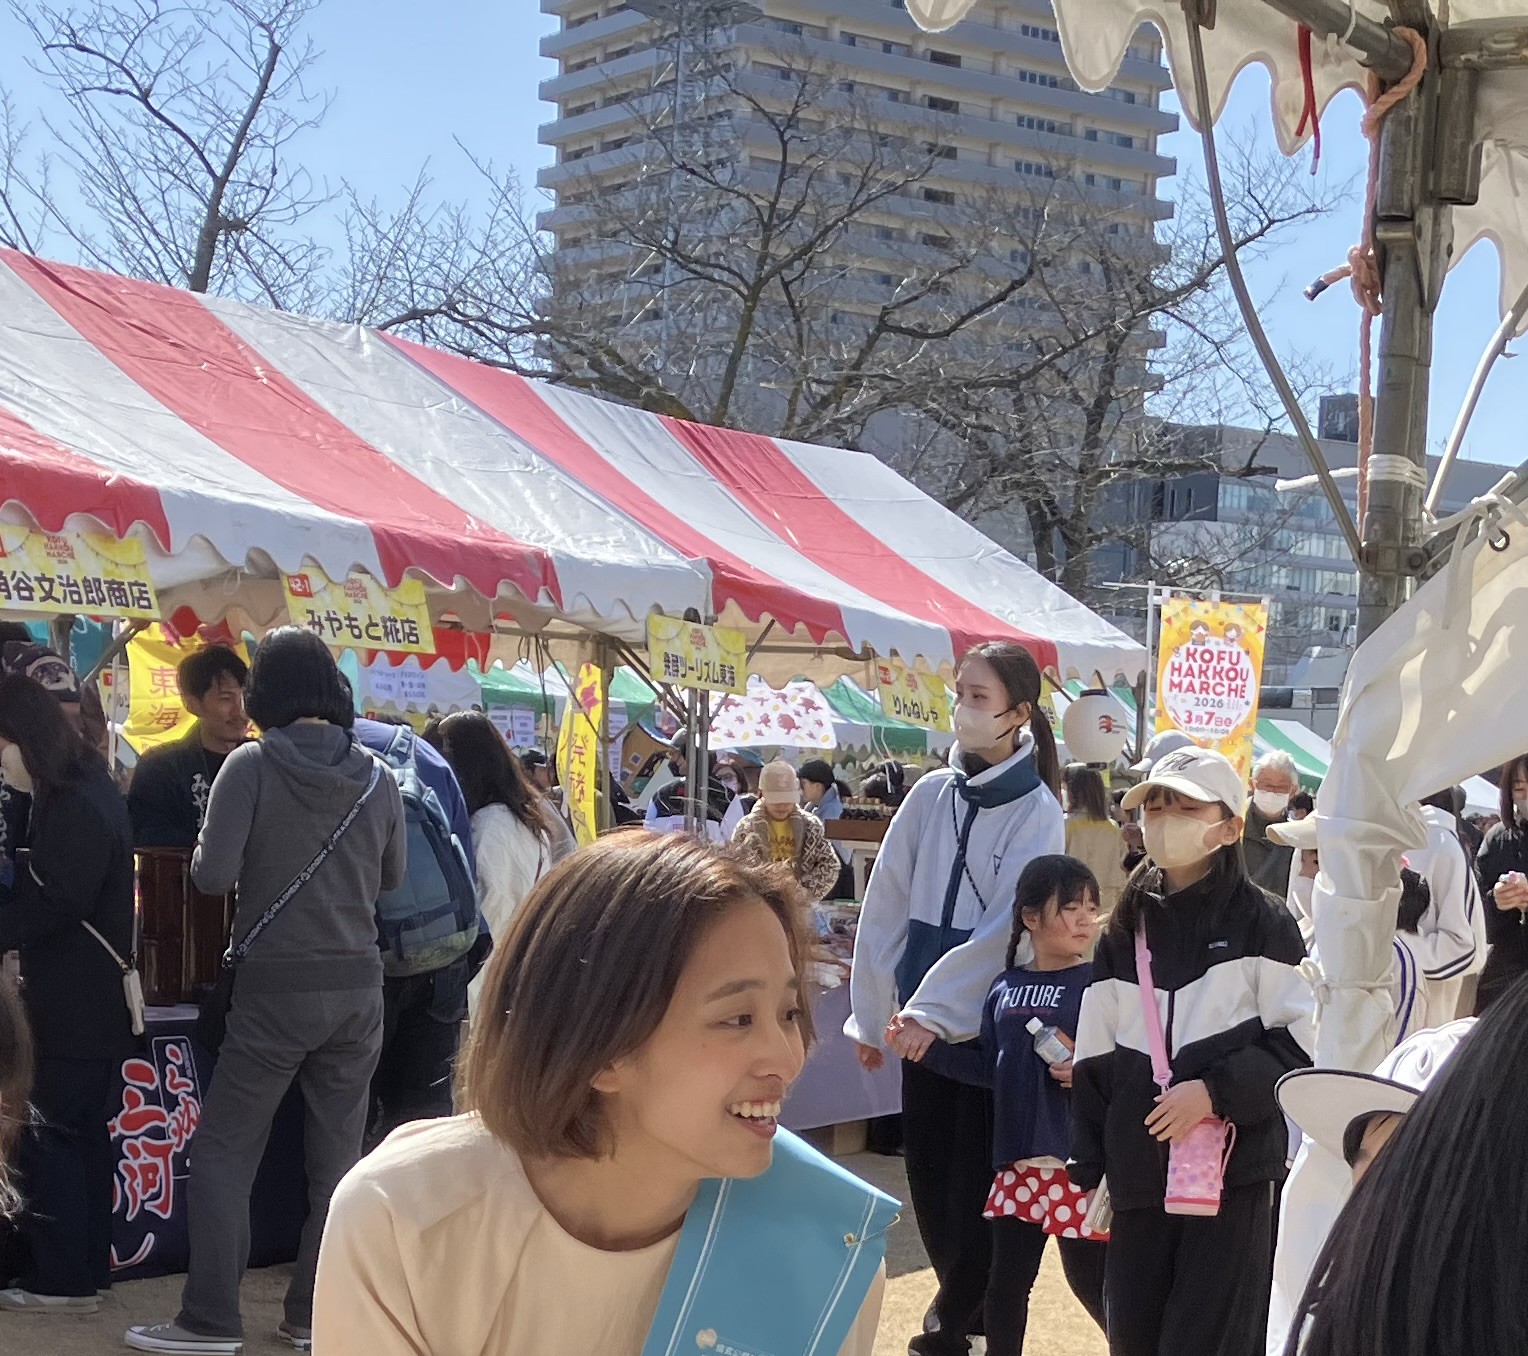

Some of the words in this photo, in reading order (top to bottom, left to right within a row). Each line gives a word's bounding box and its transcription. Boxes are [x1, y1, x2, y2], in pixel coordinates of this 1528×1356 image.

[306, 609, 420, 645] みやもと糀店
[1185, 647, 1241, 666] KOFU
[1170, 662, 1250, 683] HAKKOU
[1193, 697, 1224, 708] 2026
[1001, 984, 1066, 1008] FUTURE
